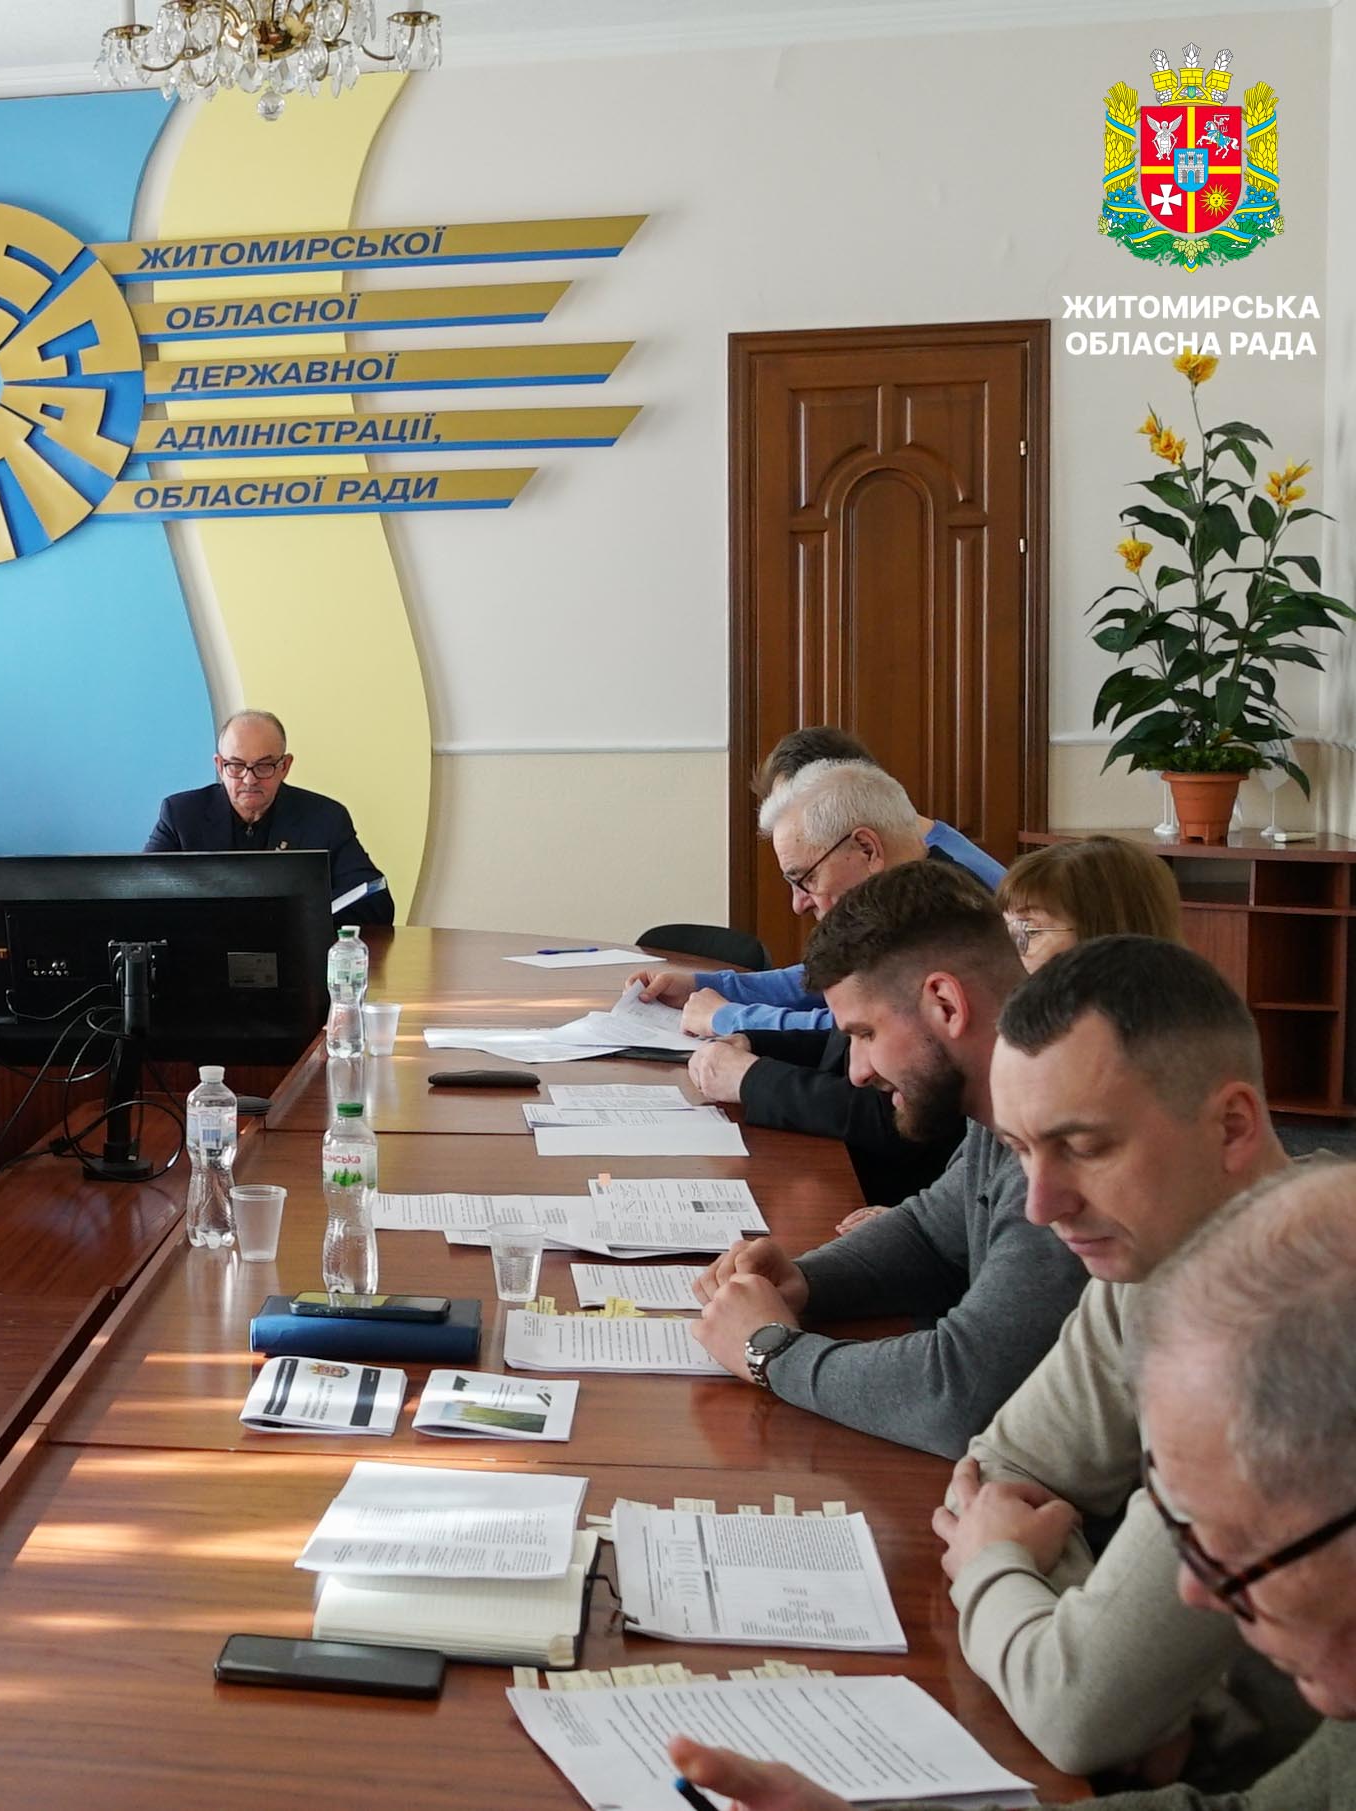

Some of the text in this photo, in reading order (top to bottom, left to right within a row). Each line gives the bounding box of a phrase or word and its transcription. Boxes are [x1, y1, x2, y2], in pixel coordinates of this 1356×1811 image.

[137, 226, 447, 270] ЖИТОМИРСЬКОЇ
[166, 293, 361, 330] ОБЛАСНОЇ
[171, 352, 400, 392] ДЕРЖАВНОЇ
[156, 413, 442, 450] АДМІНІСТРАЦІЇ,
[134, 476, 439, 509] ОБЛАСНОЇ РАДИ
